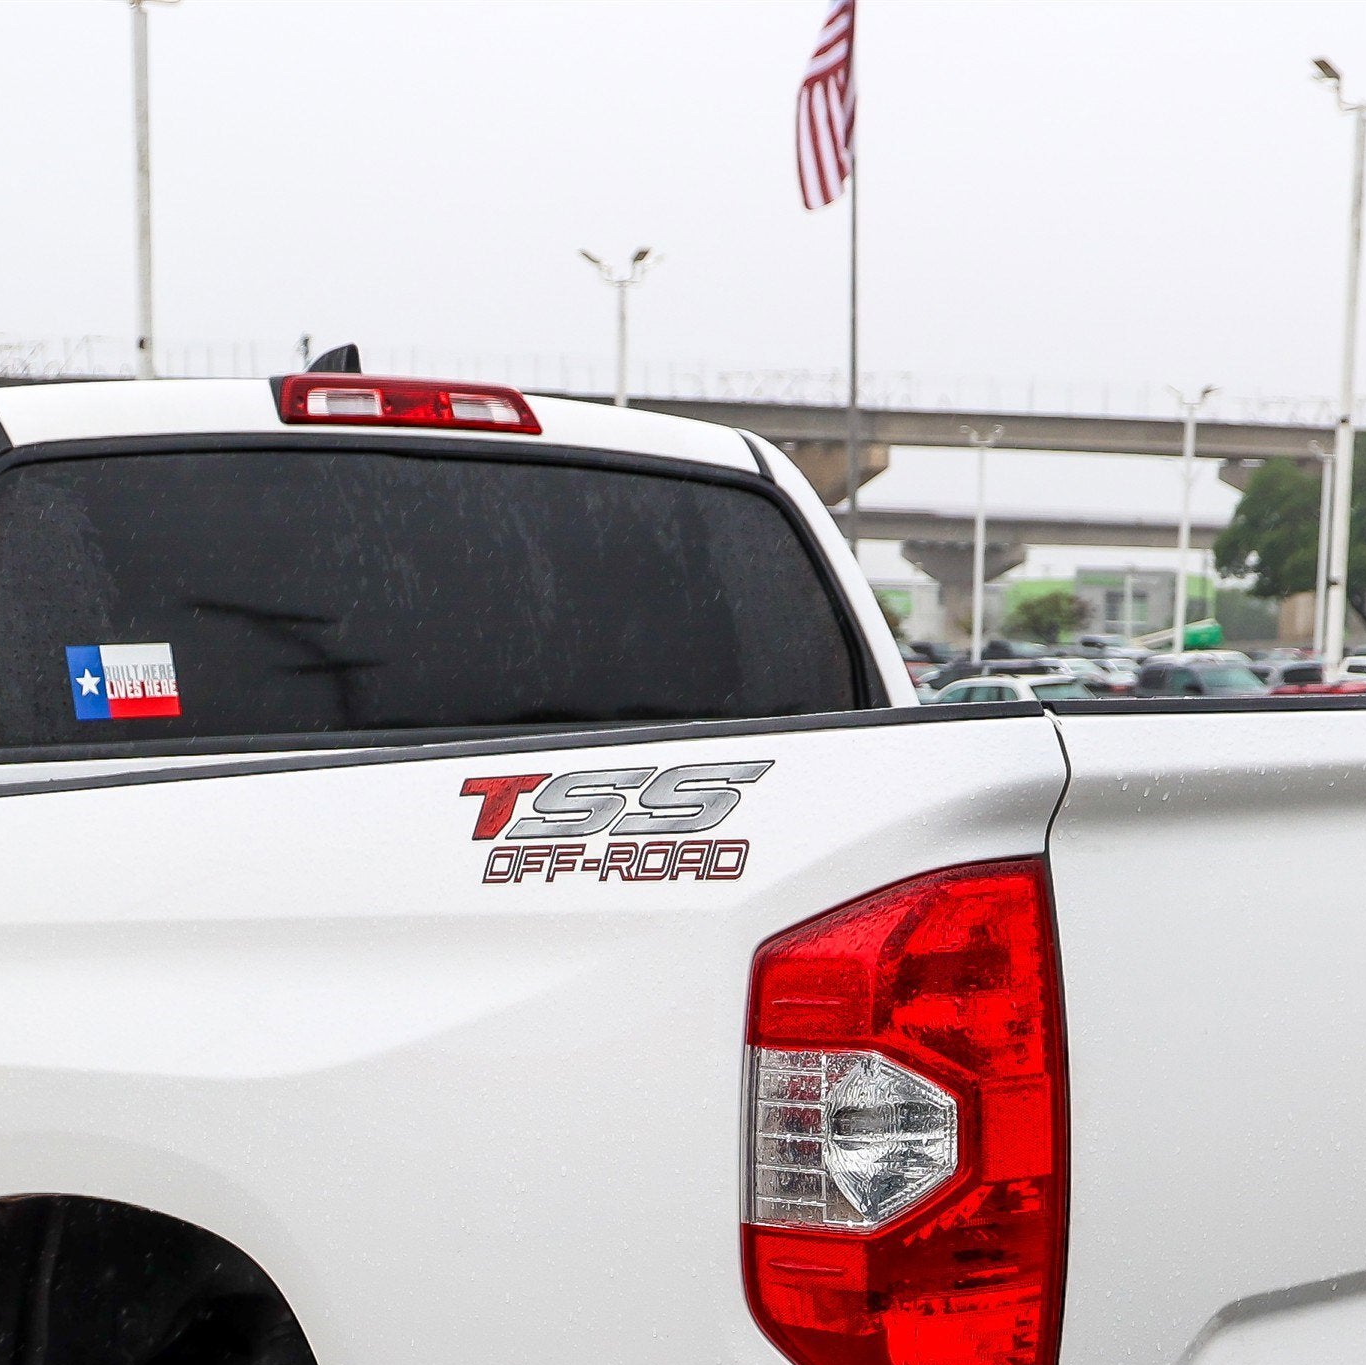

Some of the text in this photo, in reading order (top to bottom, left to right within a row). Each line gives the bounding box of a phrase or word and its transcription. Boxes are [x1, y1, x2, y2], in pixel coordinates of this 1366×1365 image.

[142, 664, 176, 680] HERE
[106, 679, 179, 699] LIVES HERE
[459, 760, 775, 840] TSS
[482, 839, 750, 884] OFF-ROAD
